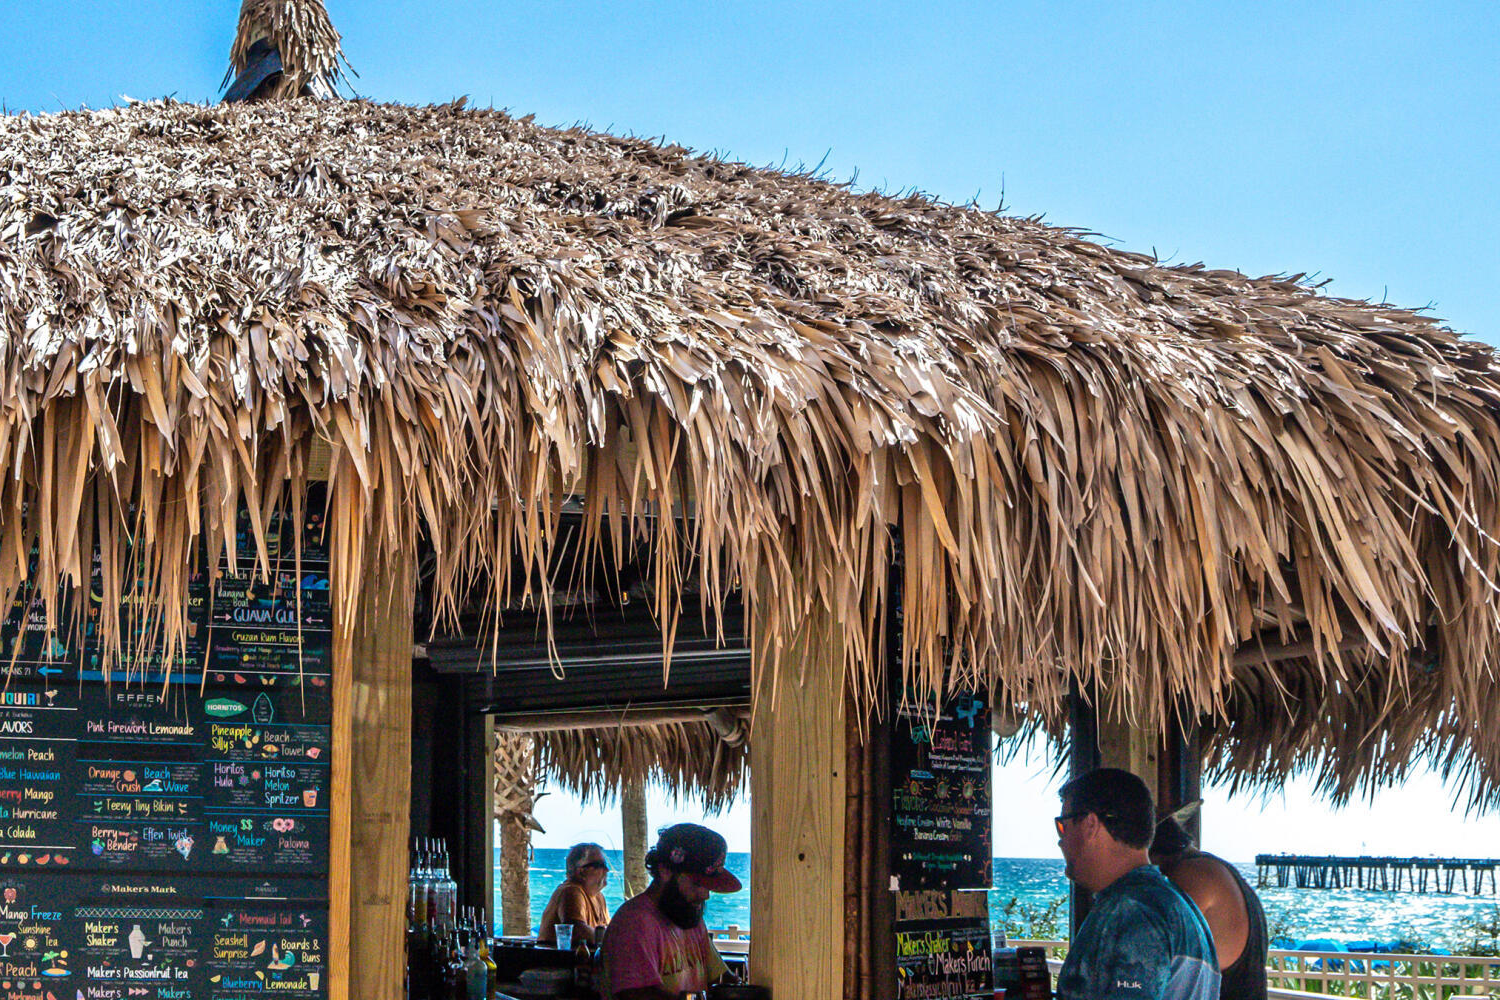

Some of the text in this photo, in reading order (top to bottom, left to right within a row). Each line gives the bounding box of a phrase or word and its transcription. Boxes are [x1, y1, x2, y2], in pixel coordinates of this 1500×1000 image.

[234, 608, 299, 624] GUAVA GUL
[232, 631, 259, 642] Cruzan
[260, 631, 277, 642] Rum
[87, 720, 194, 736] Pink Firework Lemonade
[212, 723, 252, 742] Pineapple
[264, 731, 290, 743] Beach
[27, 748, 54, 762] Peach
[19, 769, 61, 781] Hawaiian
[88, 766, 120, 783] Orange
[144, 766, 171, 780] Beach
[116, 780, 141, 793] Crush
[163, 780, 189, 793] Wave
[264, 779, 290, 791] Melon
[24, 787, 54, 805] Mango
[153, 800, 174, 813] Bikini
[12, 807, 58, 820] Hurricane
[7, 826, 36, 839] Colada
[92, 826, 118, 842] Berry
[210, 820, 238, 837] Money
[107, 839, 138, 851] Bender
[237, 834, 266, 847] Maker
[278, 837, 310, 850] Paloma
[111, 885, 177, 894] Maker's Mark
[31, 905, 62, 920] Freeze
[17, 923, 51, 935] Sunshine
[85, 921, 119, 934] Maker's
[158, 922, 192, 935] Maker's
[45, 936, 59, 947] Tea
[86, 934, 118, 947] Shaker
[162, 935, 188, 948] Punch
[214, 934, 248, 948] Seashell
[281, 938, 311, 951] Boards
[925, 932, 950, 954] Shaker
[213, 947, 249, 962] Surprise
[301, 951, 321, 963] Buns
[936, 950, 991, 975] Maker's Punch
[5, 962, 37, 977] Peach
[87, 966, 189, 979] Maker's Tea
[222, 977, 308, 992] Blueberry Lemonade
[1117, 979, 1142, 990] Huk
[87, 987, 121, 999] Maker's
[157, 987, 191, 1000] Maker's
